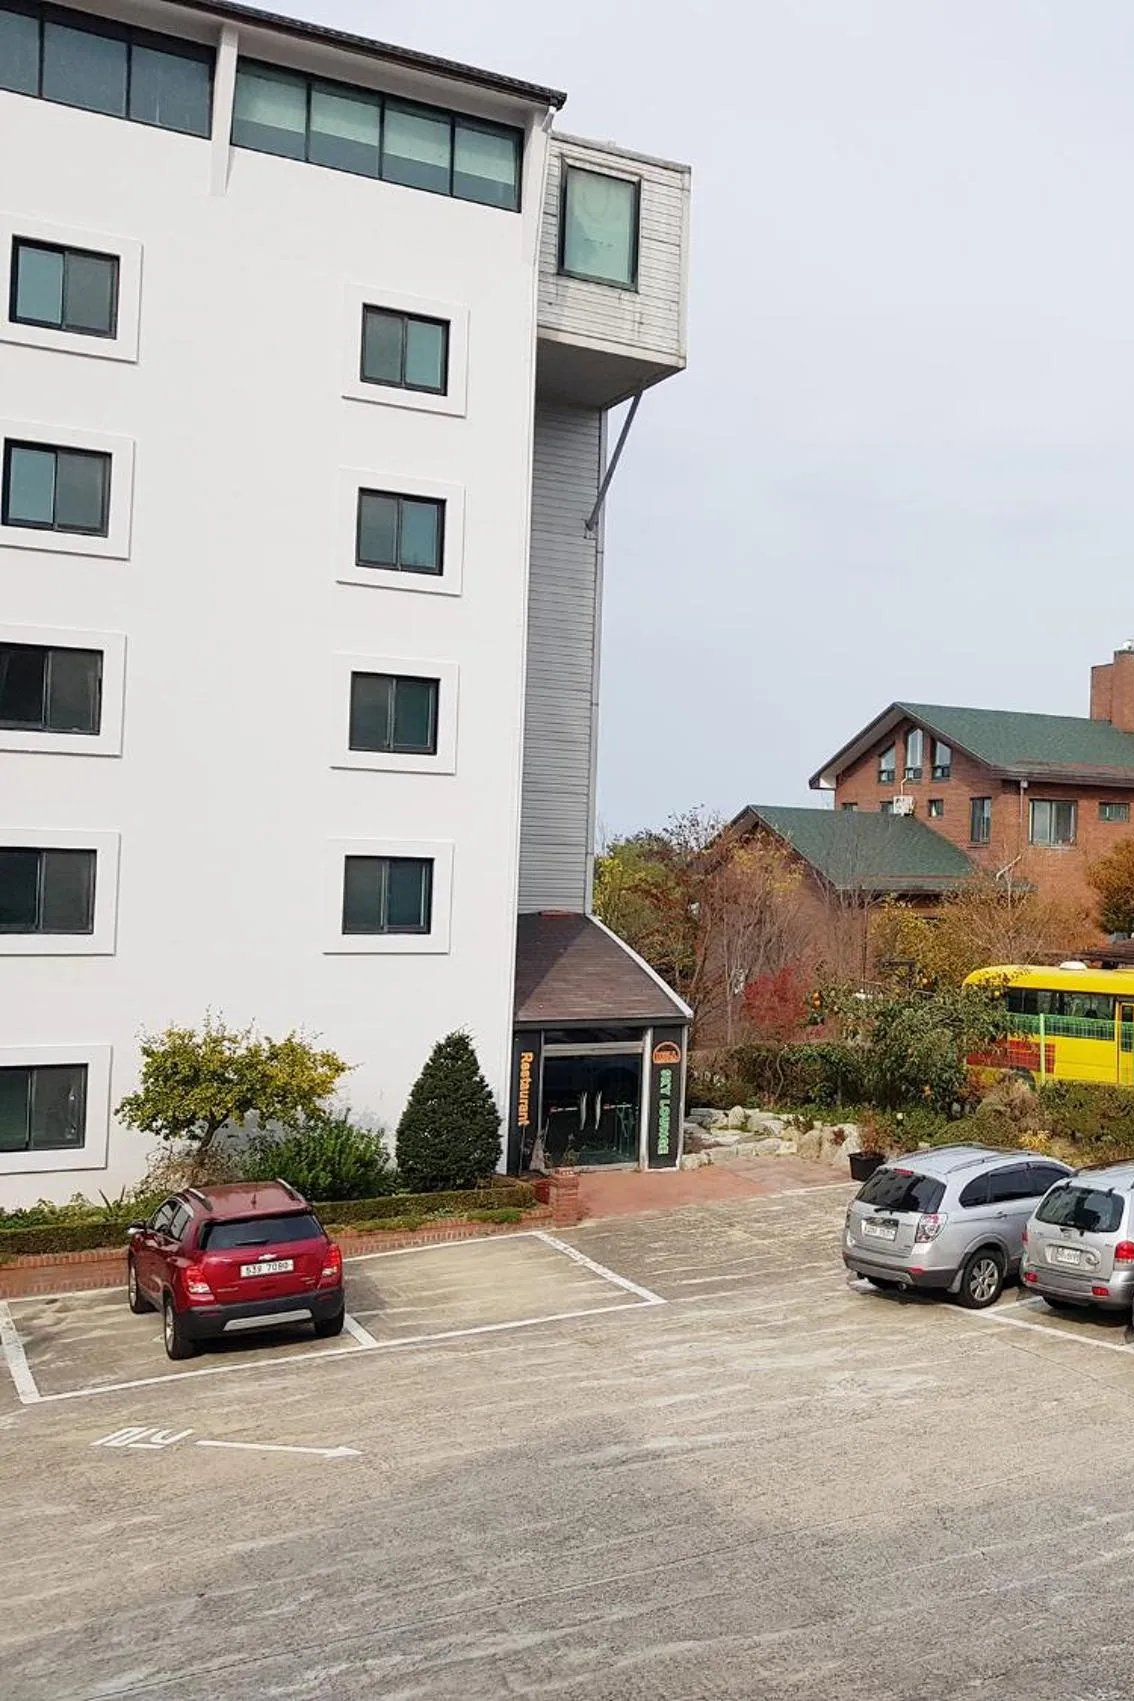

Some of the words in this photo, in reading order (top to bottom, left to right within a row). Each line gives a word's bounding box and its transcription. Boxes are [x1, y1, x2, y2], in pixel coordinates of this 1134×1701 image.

[517, 1051, 534, 1127] Restaurant
[659, 1068, 672, 1096] SKY
[657, 1099, 671, 1155] LOUNGE
